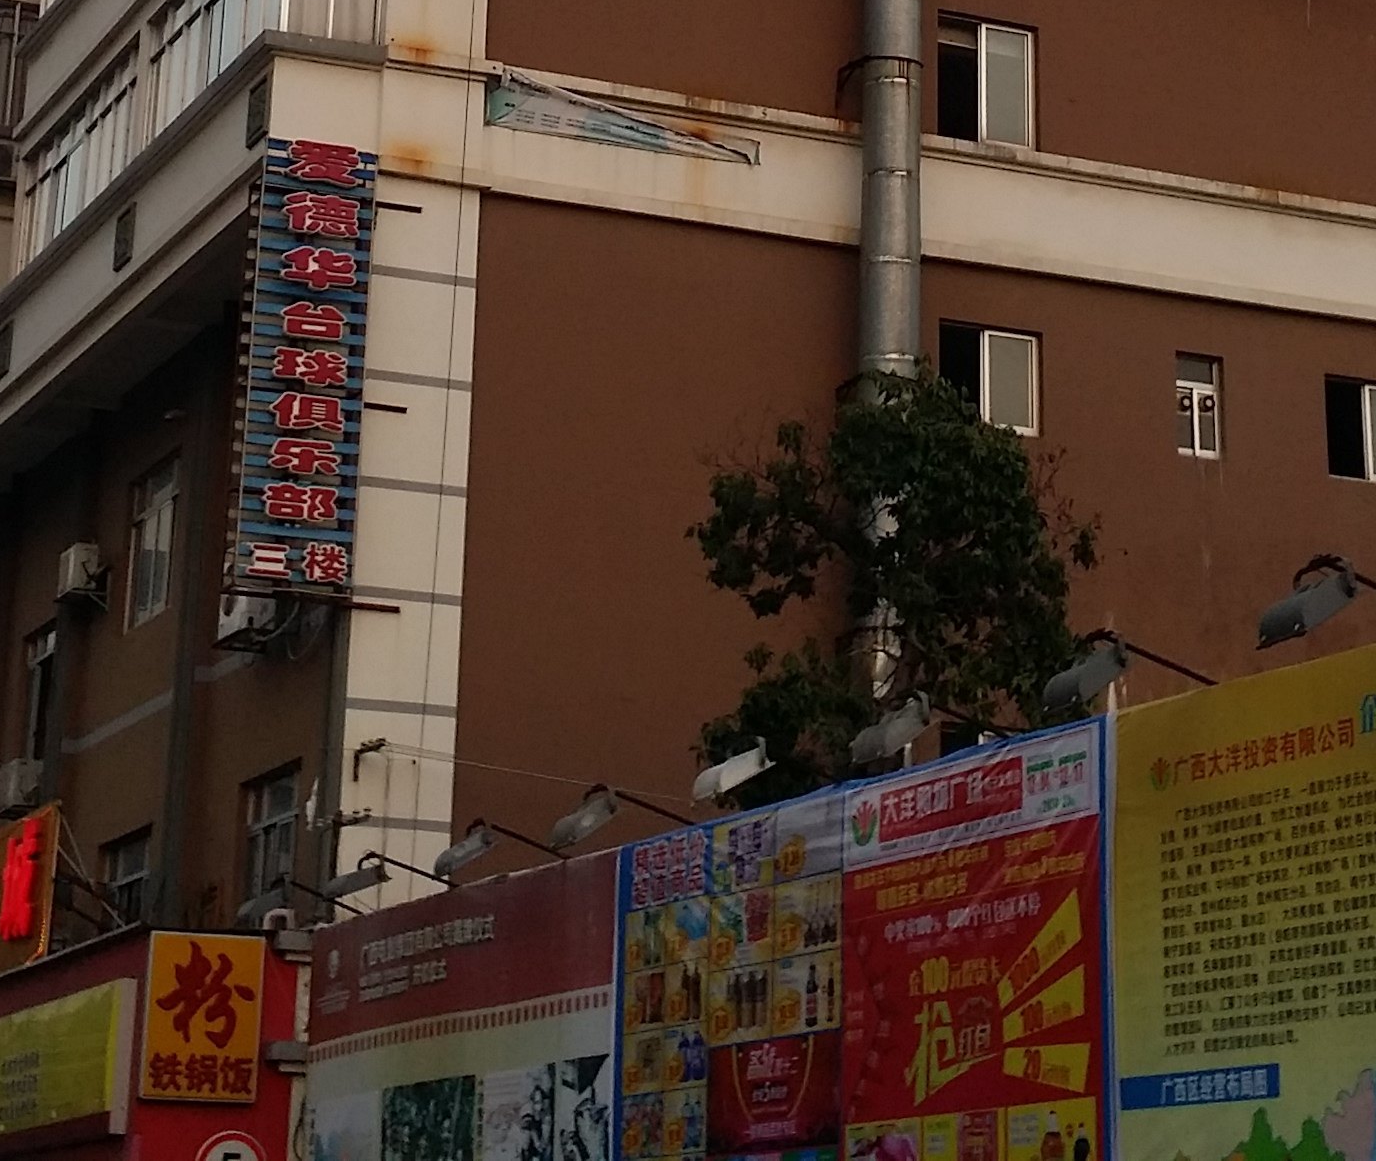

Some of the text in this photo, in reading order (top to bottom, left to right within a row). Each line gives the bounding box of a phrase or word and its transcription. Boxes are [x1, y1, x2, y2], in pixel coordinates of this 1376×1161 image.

[263, 138, 362, 523] 爱德华台球俱乐部
[246, 540, 349, 584] 三楼
[1172, 717, 1355, 785] 广西大洋投资有限公司
[155, 939, 256, 1050] 粉
[148, 1051, 254, 1096] 铁锅饭
